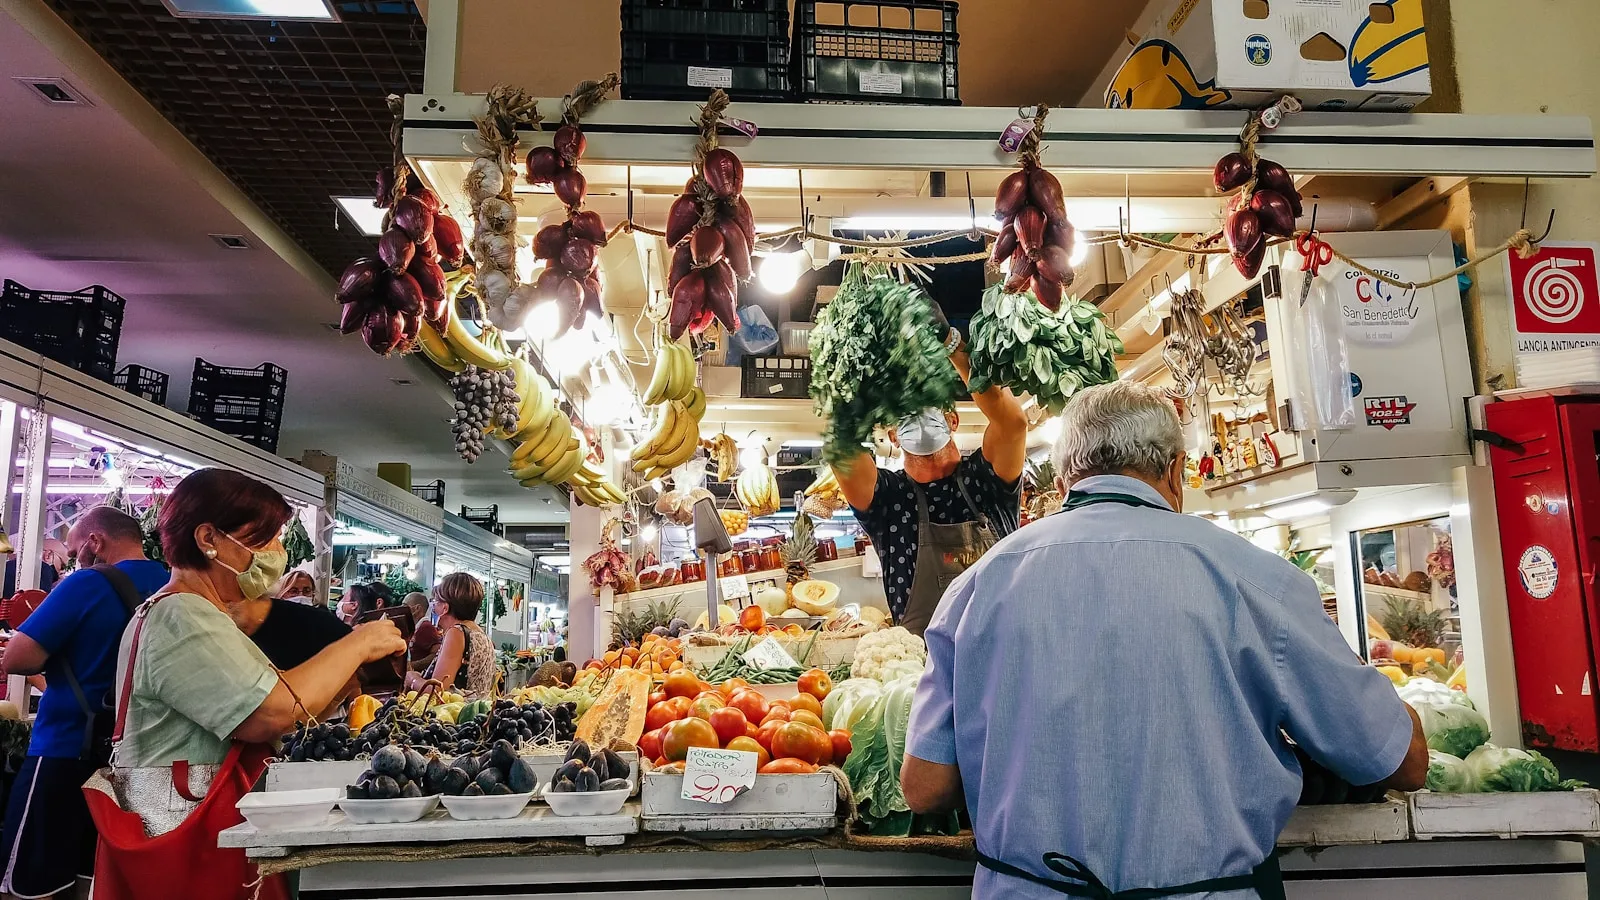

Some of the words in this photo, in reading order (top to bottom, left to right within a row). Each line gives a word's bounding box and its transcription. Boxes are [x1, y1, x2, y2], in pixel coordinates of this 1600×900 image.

[1345, 268, 1400, 280] Conorzio
[1343, 305, 1361, 319] San
[1364, 306, 1408, 321] Benedetto
[1518, 340, 1549, 352] LANCIA
[1365, 397, 1406, 409] RTL
[1369, 409, 1403, 417] 102.5
